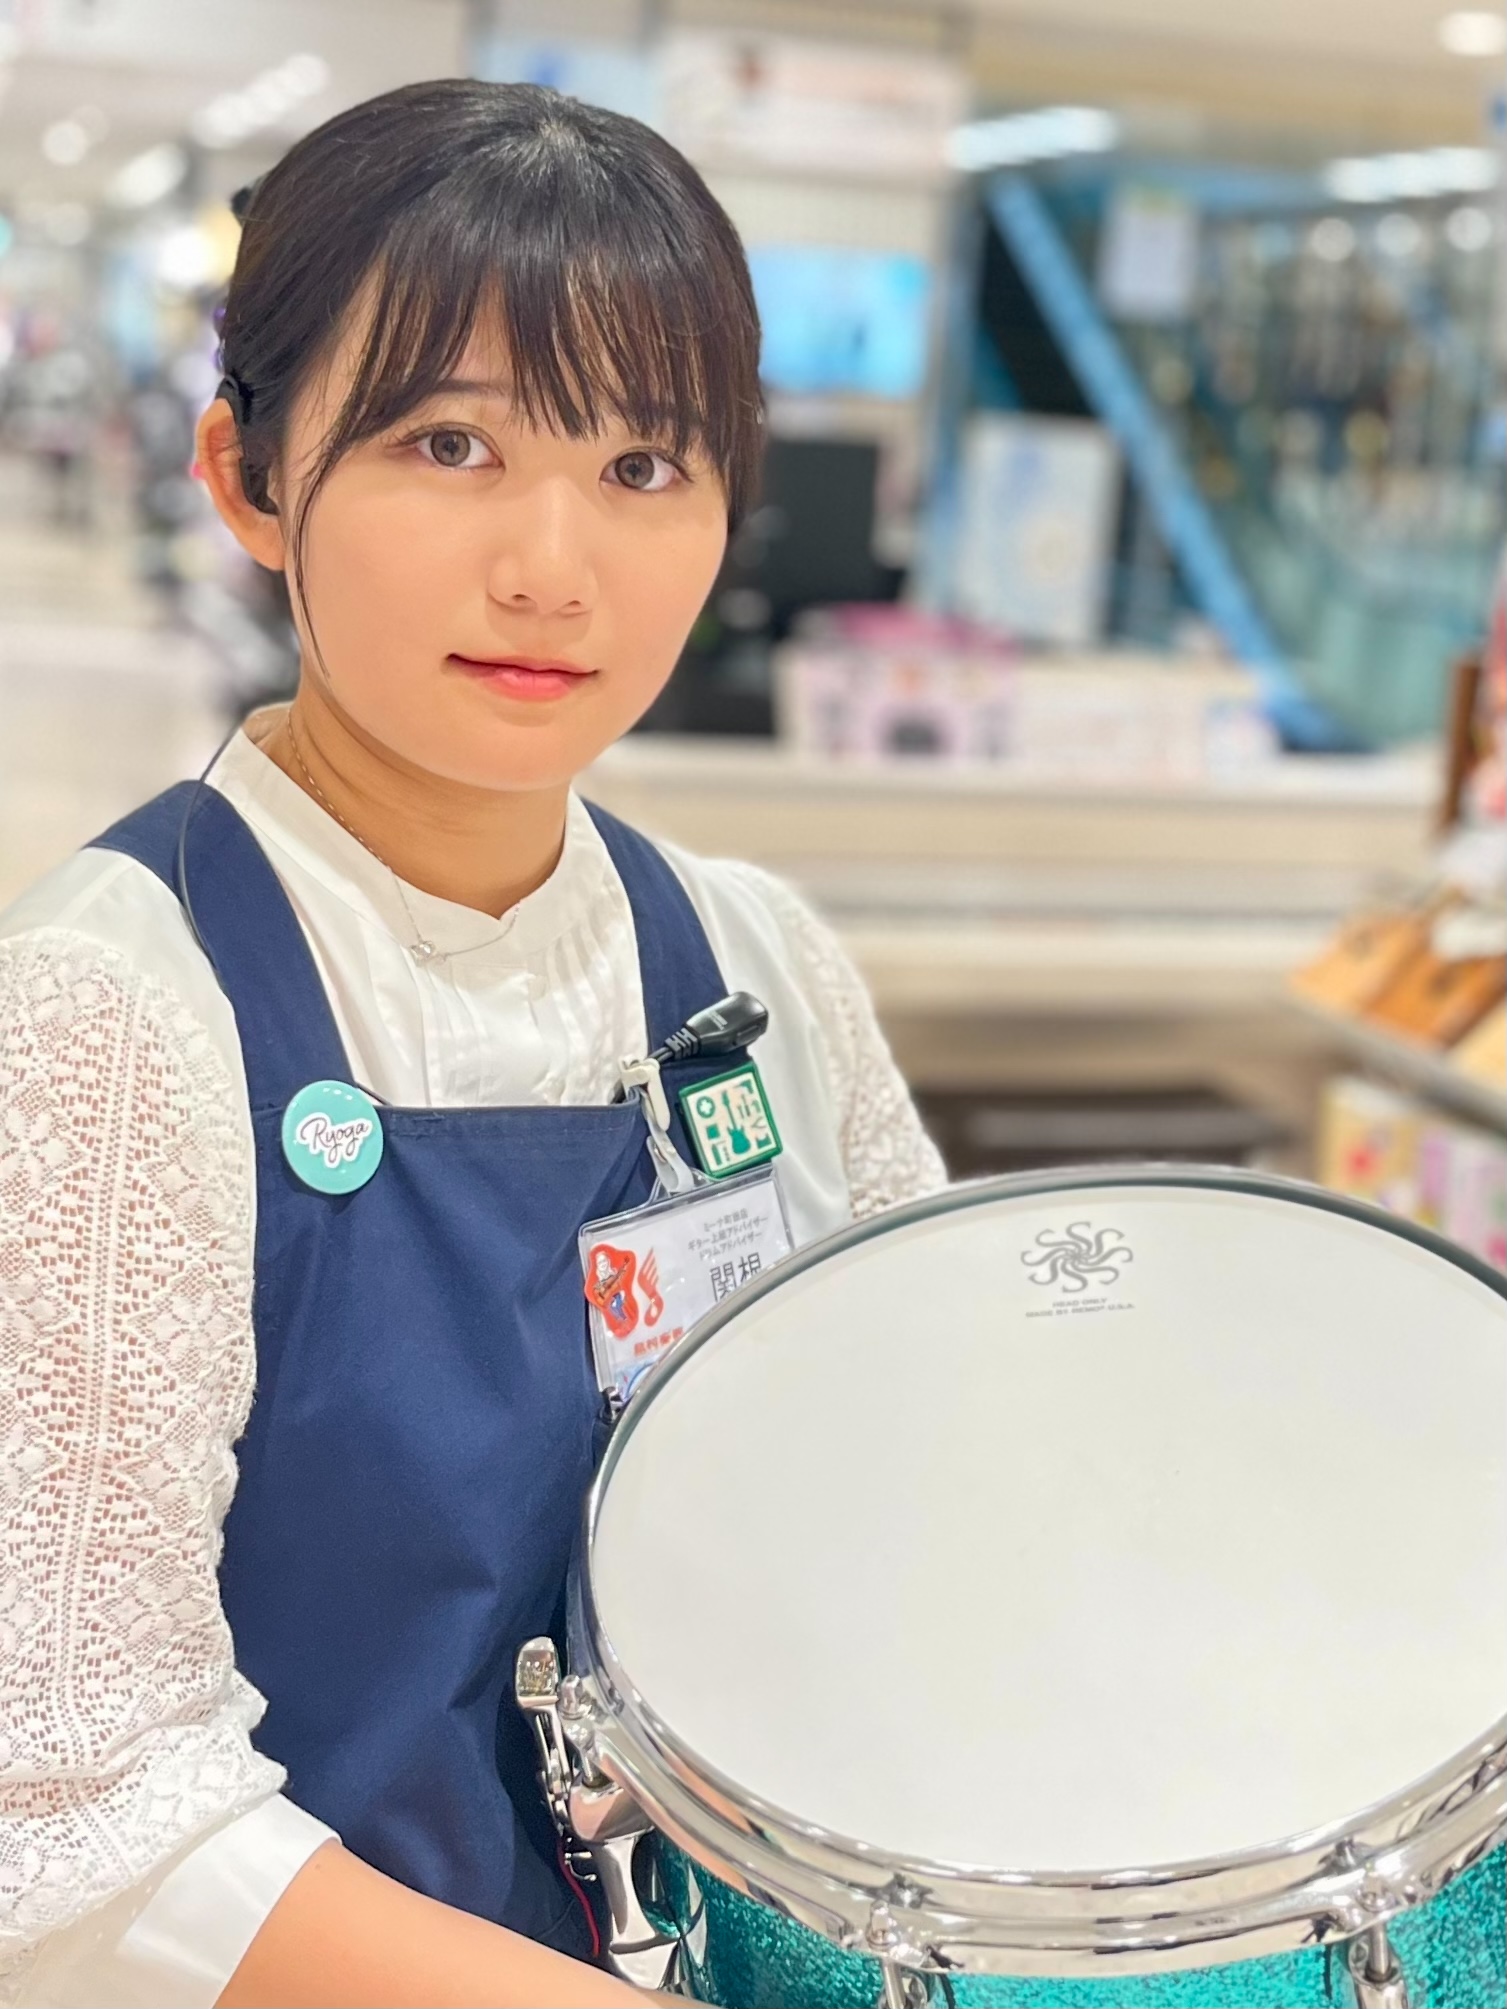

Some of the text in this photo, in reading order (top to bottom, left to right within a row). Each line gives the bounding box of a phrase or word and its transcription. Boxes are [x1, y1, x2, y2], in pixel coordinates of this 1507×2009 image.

[300, 1117, 370, 1164] Ryoga
[1052, 1298, 1108, 1308] HEAD ONLY
